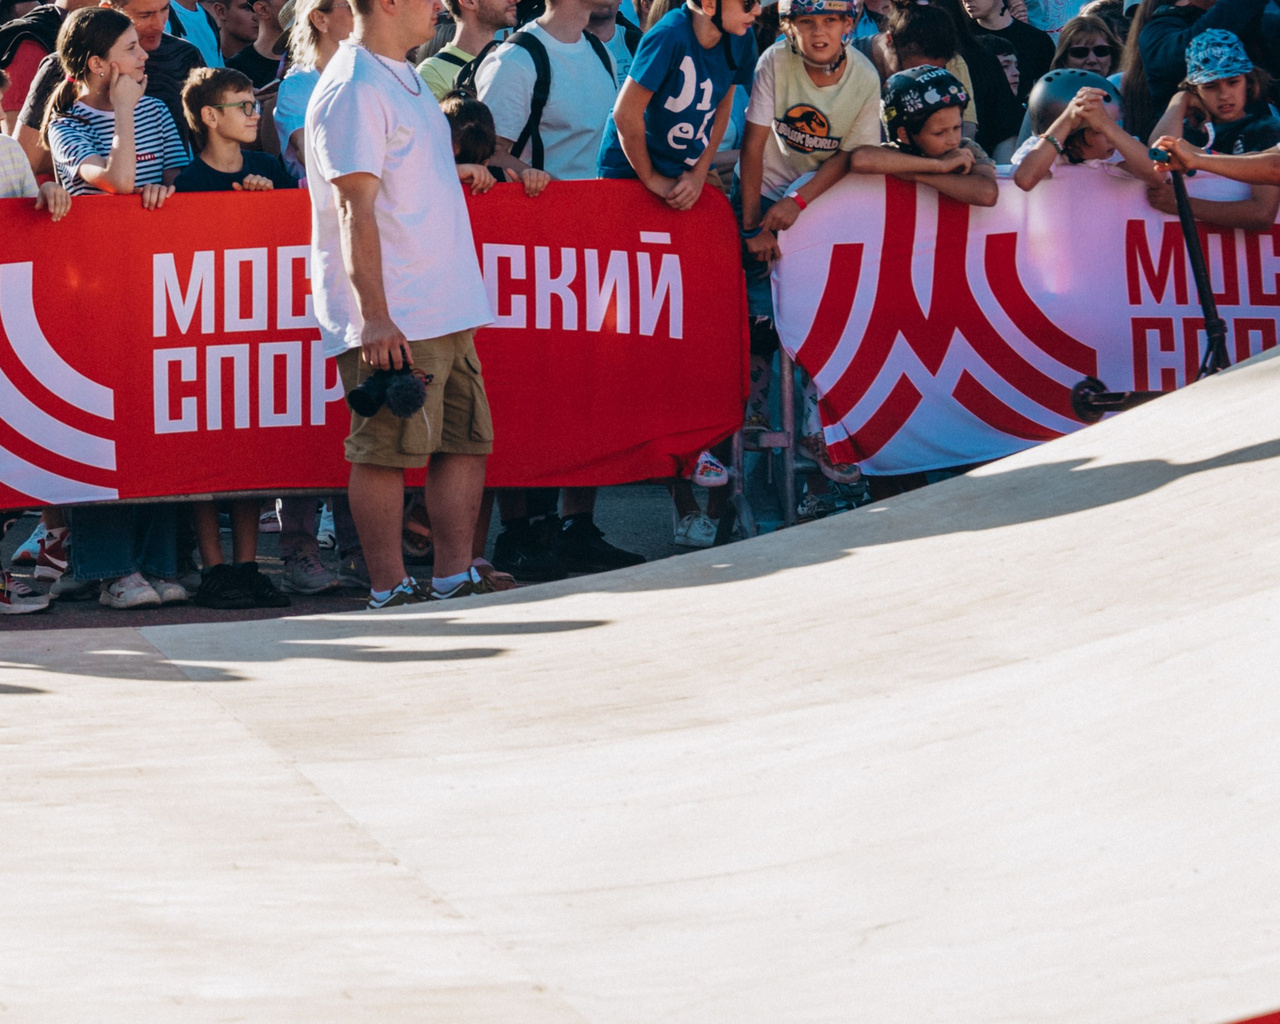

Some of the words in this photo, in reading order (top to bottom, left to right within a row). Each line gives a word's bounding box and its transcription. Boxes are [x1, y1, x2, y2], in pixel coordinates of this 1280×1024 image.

[805, 134, 839, 150] WORLD
[152, 230, 684, 340] МОССКИЙ
[1125, 219, 1280, 306] МОС
[152, 339, 346, 435] СПОР
